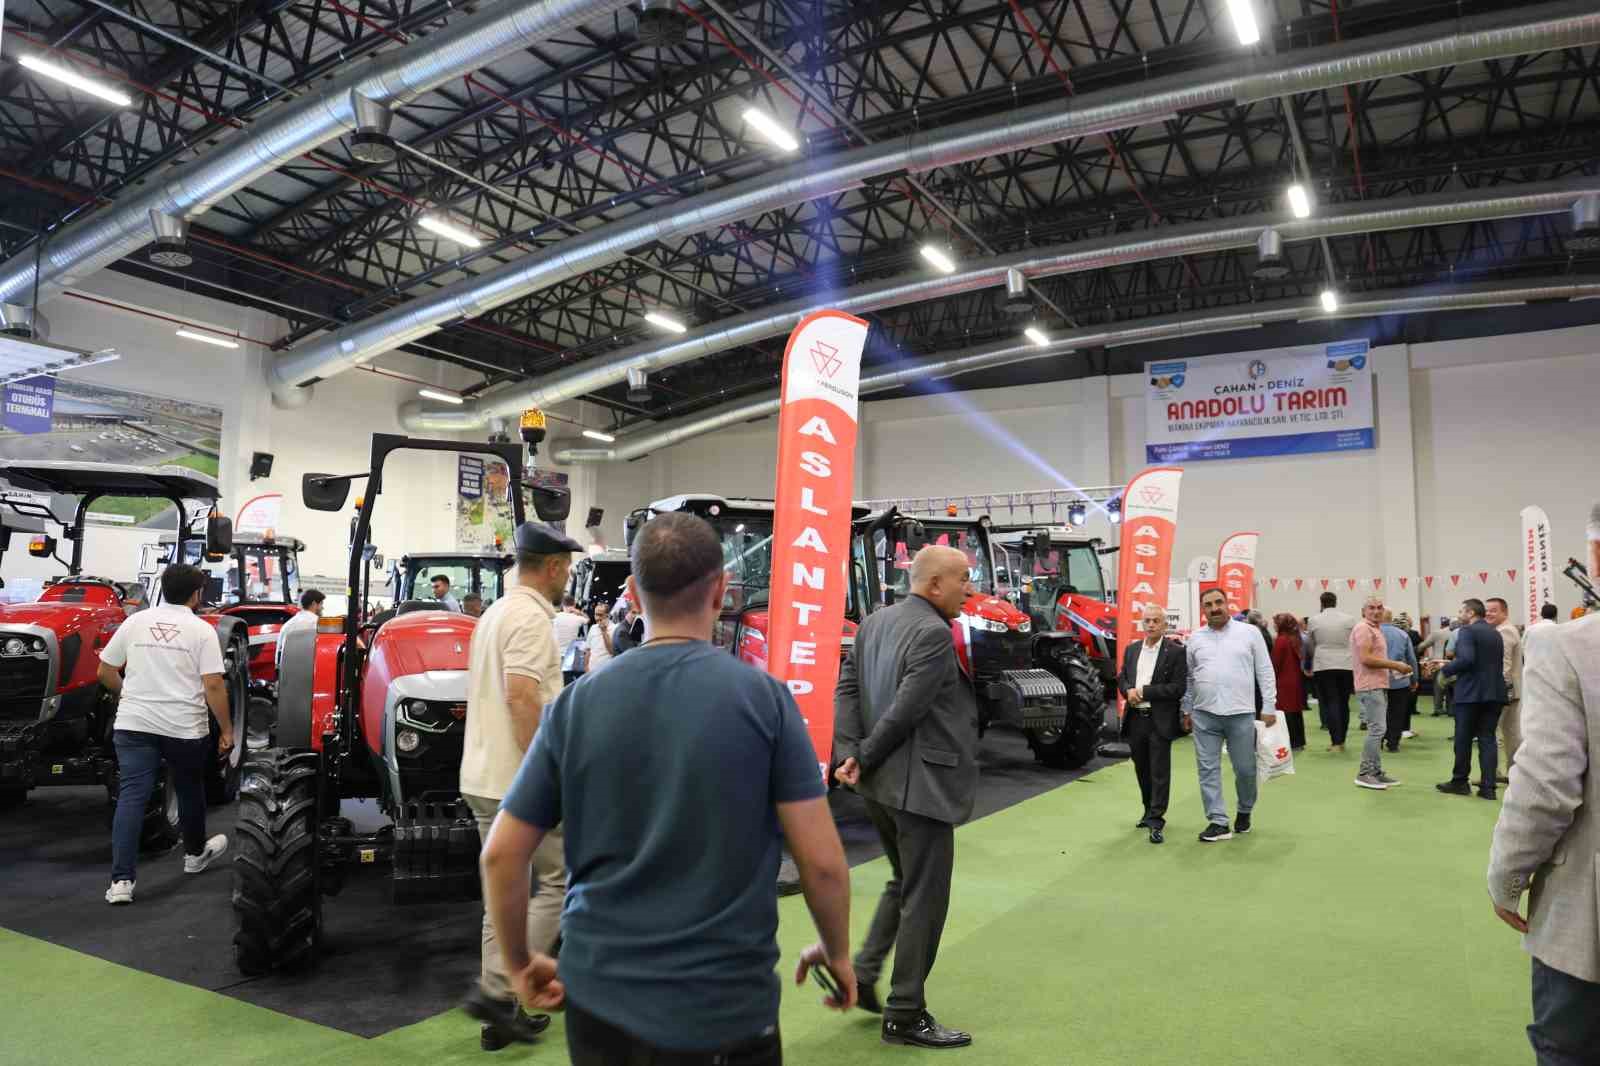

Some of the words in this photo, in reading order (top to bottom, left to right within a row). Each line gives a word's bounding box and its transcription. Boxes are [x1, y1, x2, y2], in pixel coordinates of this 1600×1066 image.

[1167, 394, 1266, 421] ANADOLU
[1272, 387, 1347, 411] TARIM
[1214, 382, 1256, 397] ÇAHAN
[1267, 377, 1305, 393] DENİZ
[787, 415, 838, 727] ASLANTEP
[1130, 524, 1161, 642] ASLANT
[1225, 568, 1246, 611] ASLA
